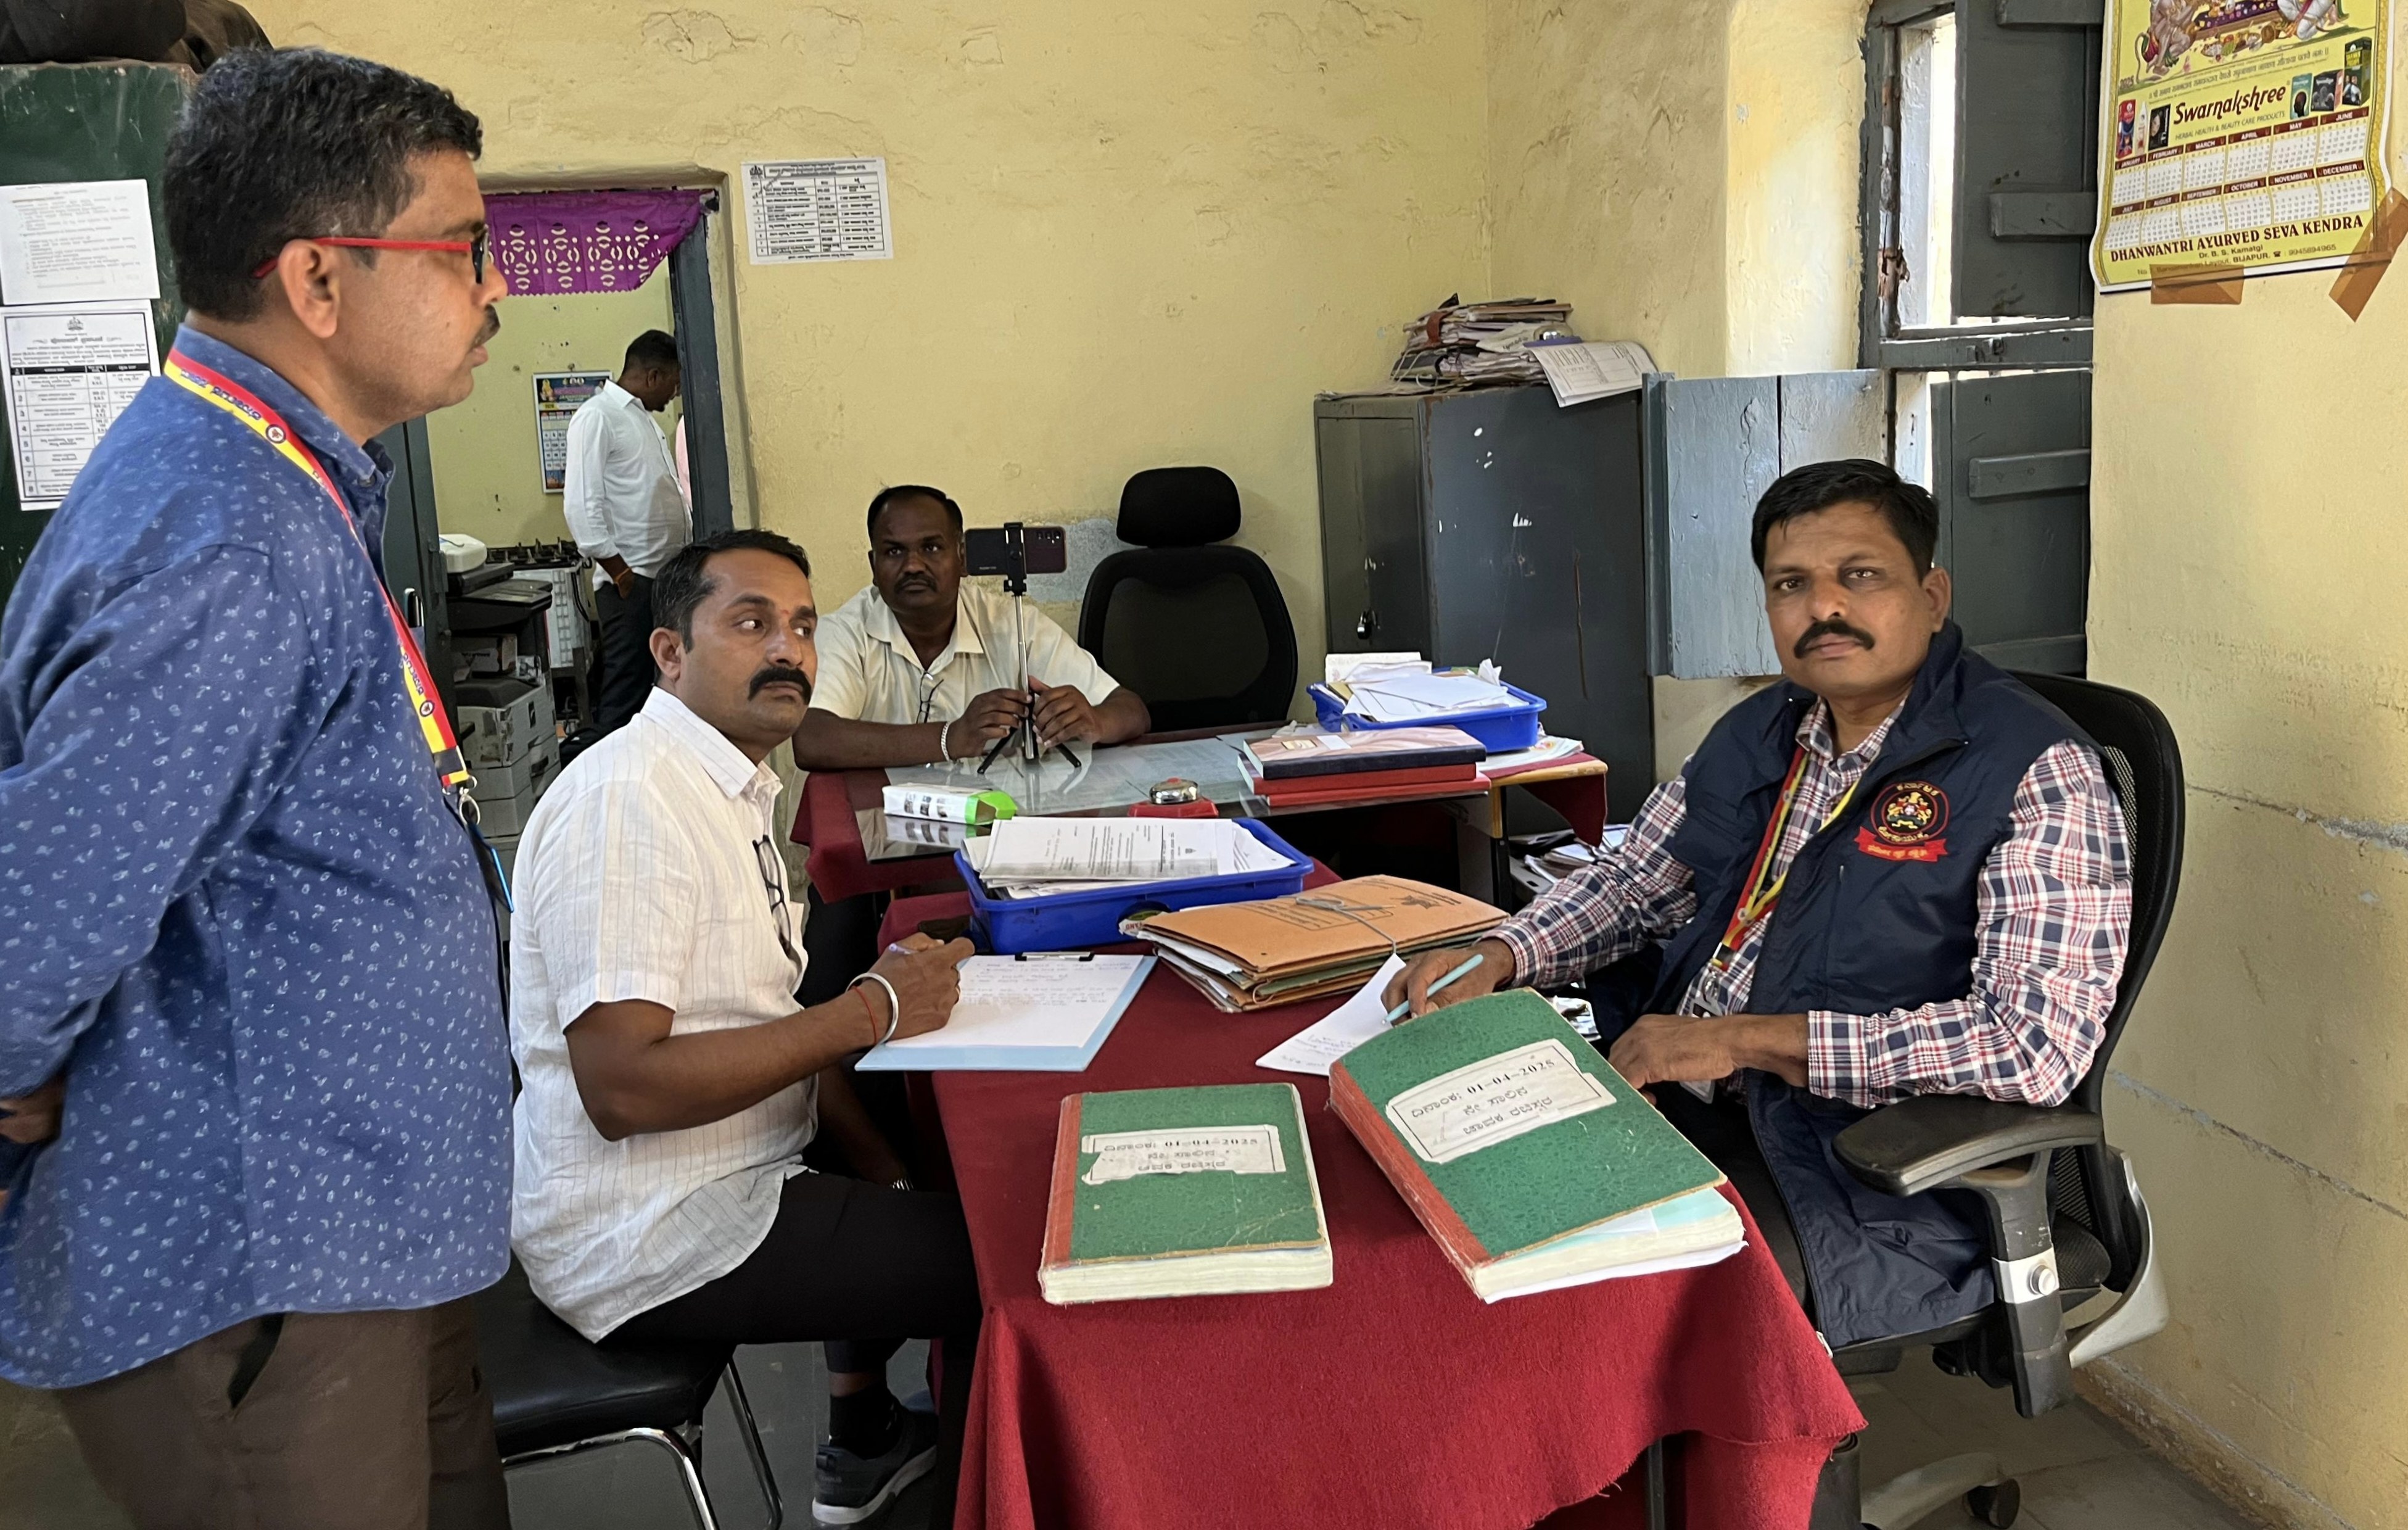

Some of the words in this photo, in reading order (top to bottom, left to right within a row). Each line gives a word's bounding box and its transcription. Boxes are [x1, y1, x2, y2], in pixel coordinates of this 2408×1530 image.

[2174, 85, 2286, 125] Swarnakshree
[2195, 126, 2214, 137] HEALTH
[2241, 116, 2256, 126] CARE
[2256, 112, 2285, 123] PRODUCTS
[2195, 141, 2216, 149] MARCH
[2241, 132, 2258, 140] APRIL
[2289, 122, 2303, 131] MAY
[2336, 112, 2353, 122] JUNE
[2231, 181, 2258, 191] OCTOBER
[2274, 173, 2308, 183] NOVEMBER
[2323, 163, 2357, 175] DECEMBER
[2111, 239, 2193, 262] DHANWANTRI
[2198, 230, 2260, 250] AYURVED
[2264, 224, 2299, 240] SEVA
[2303, 215, 2363, 235] KENDRA
[1467, 1060, 1555, 1094] 01-04-2025
[1165, 1138, 1258, 1147] 01-04-2025
